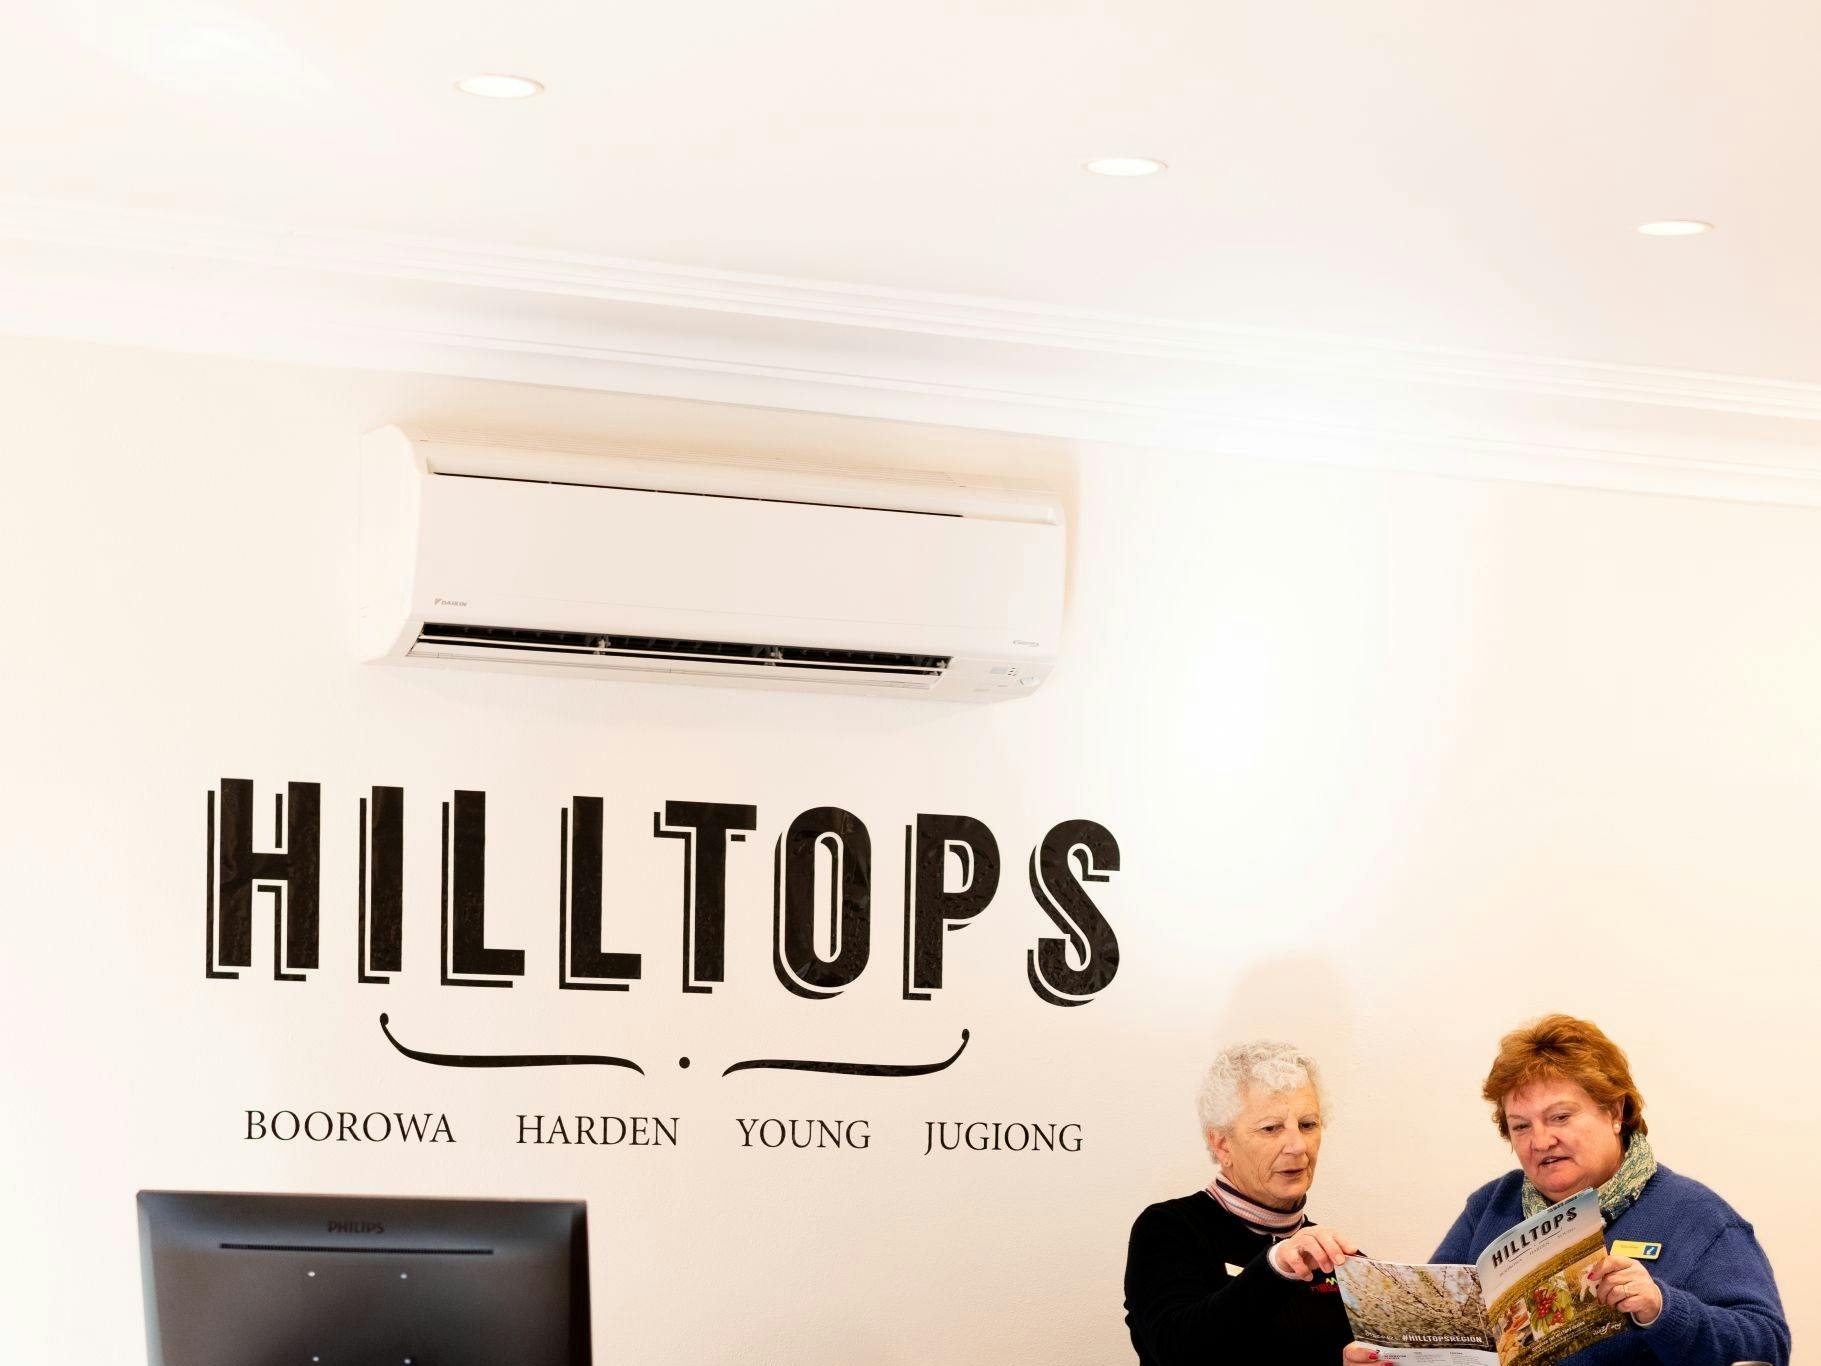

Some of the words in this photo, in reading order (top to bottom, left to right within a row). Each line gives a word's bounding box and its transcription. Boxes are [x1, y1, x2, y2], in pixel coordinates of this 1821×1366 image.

[206, 778, 1120, 1007] HILLTOPS
[245, 1111, 456, 1142] BOOROWA
[517, 1115, 679, 1146] HARDEN
[736, 1119, 870, 1149] YOUNG
[925, 1122, 1083, 1155] JUGIONG
[327, 1221, 384, 1234] PHILIPS
[1492, 1206, 1578, 1268] HILLTOPS
